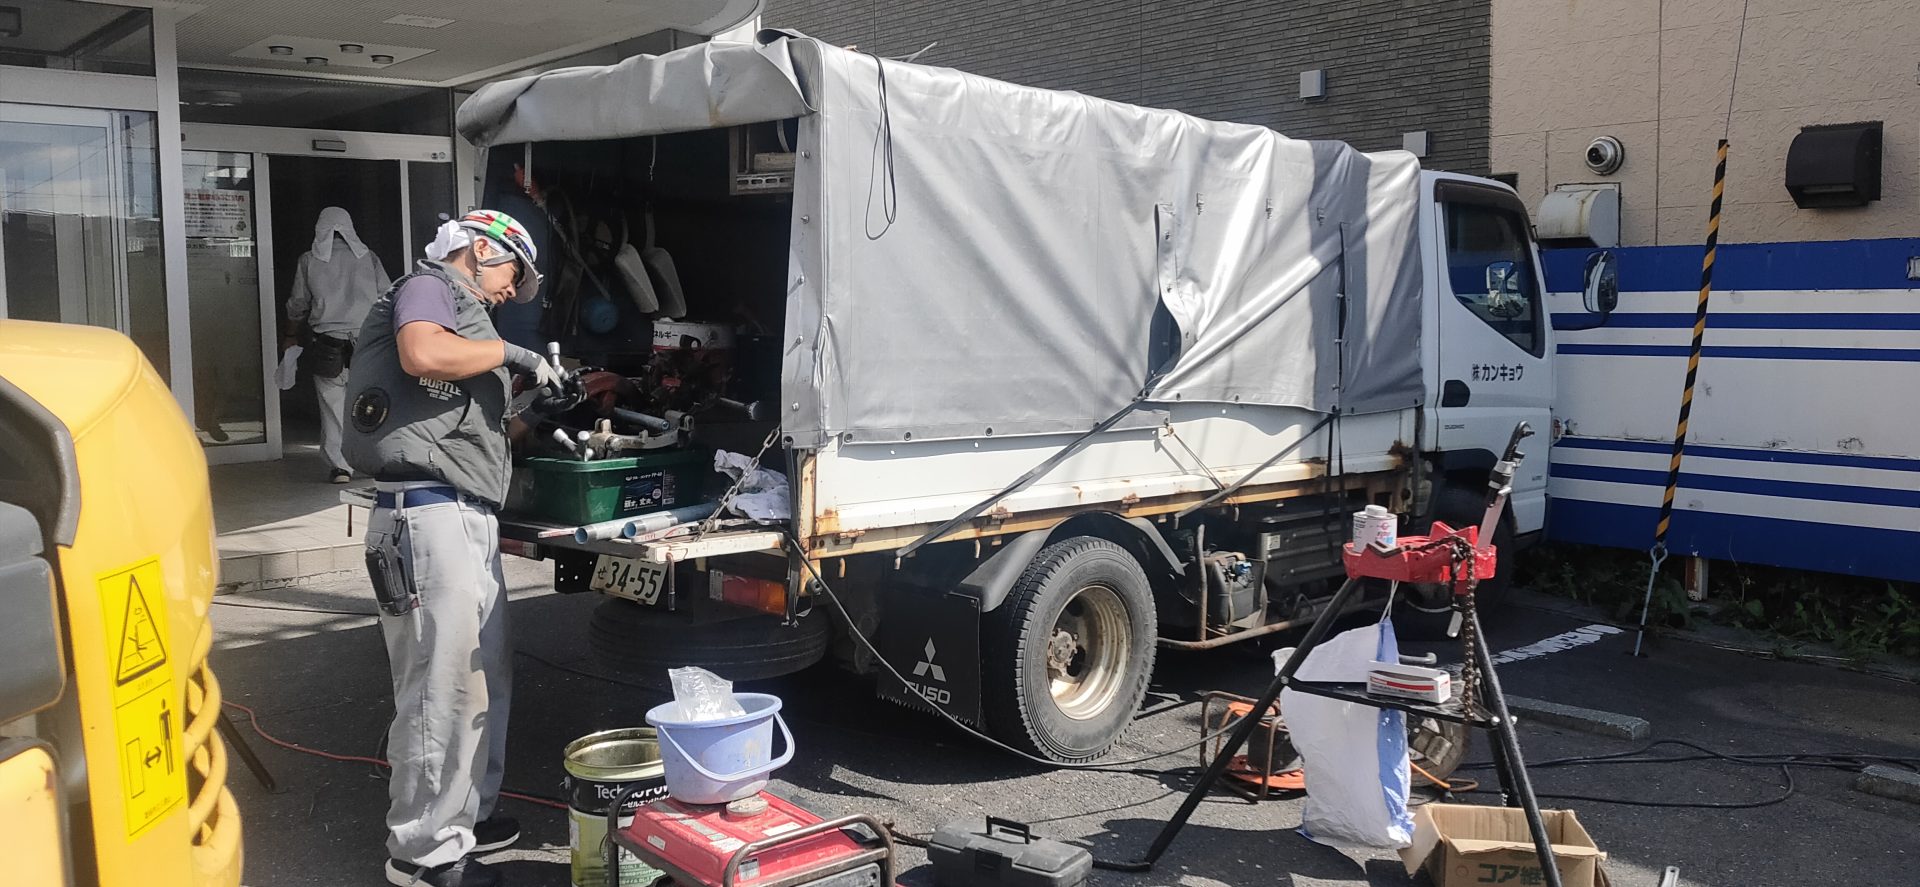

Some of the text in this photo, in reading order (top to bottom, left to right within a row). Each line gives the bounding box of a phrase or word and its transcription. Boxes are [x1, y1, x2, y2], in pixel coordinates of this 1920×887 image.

[419, 377, 462, 396] BURTLE
[598, 561, 662, 599] せ 34-55
[904, 681, 951, 705] FUSO
[1477, 863, 1563, 886] コア継
